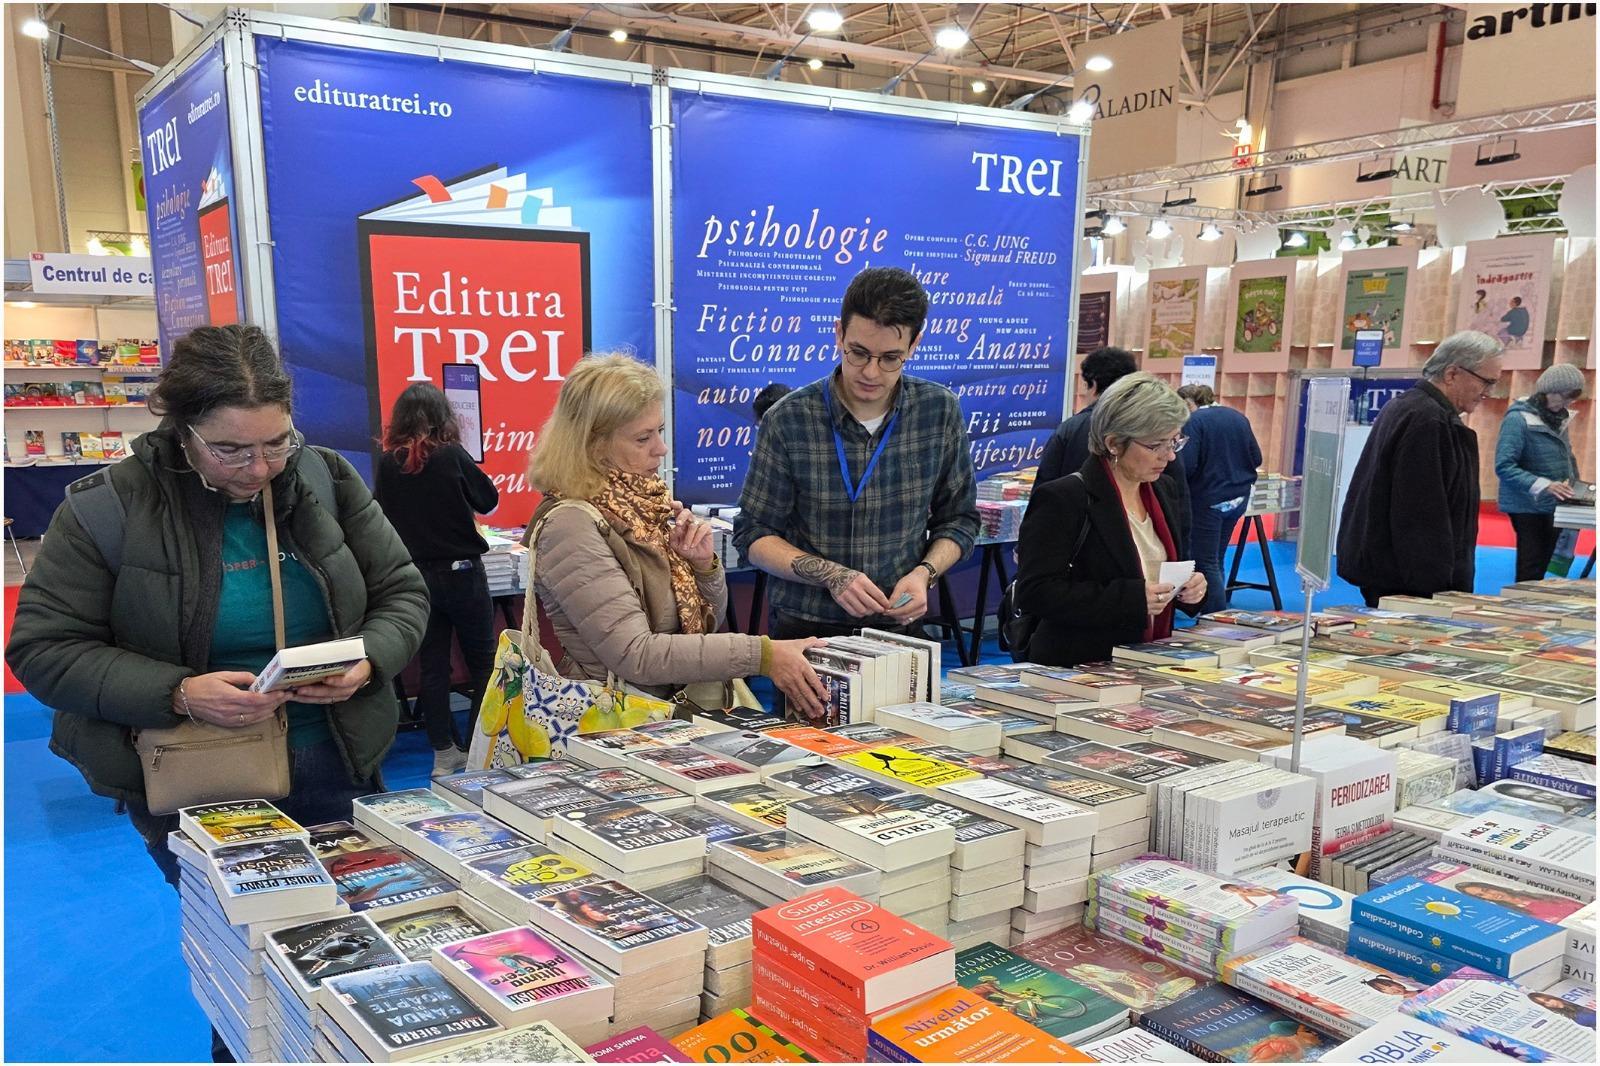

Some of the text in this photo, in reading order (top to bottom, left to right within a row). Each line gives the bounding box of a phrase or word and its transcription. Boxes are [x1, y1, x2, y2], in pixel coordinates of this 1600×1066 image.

[293, 79, 453, 118] edituratrei.ro
[147, 117, 181, 176] TREI
[972, 152, 1063, 196] TREI
[1396, 155, 1447, 184] ART
[204, 232, 230, 259] Editura
[696, 205, 888, 264] psihologie
[964, 234, 990, 248] C.G.
[993, 235, 1030, 250] JUNG
[964, 250, 1012, 266] Sigmund
[1015, 251, 1057, 265] FREUD
[43, 265, 132, 283] Centrul de
[207, 259, 233, 296] TREI
[393, 271, 565, 319] Editura
[696, 304, 801, 333] Fiction
[393, 326, 566, 382] TREI
[967, 333, 1052, 360] Anansi
[958, 384, 1006, 398] pentru
[1012, 380, 1048, 400] copii
[966, 411, 1001, 434] Fii
[696, 425, 751, 449] non
[970, 438, 1043, 470] lifestyle
[1331, 773, 1391, 808] PERIODIZAREA
[1513, 771, 1549, 786] LIMITE
[617, 828, 691, 849] ANA REYES
[877, 822, 935, 841] CHILD
[1228, 810, 1305, 840] Masajul terapeutic
[1311, 826, 1321, 880] PERIODIZAREA
[236, 875, 325, 892] LOUISE PENNY
[1526, 879, 1556, 892] KILLAM
[1539, 865, 1569, 879] KILLAM
[363, 887, 440, 908] MINIER
[789, 897, 832, 917] Super
[1360, 909, 1424, 939] Codul circadian
[757, 929, 789, 957] intestinul
[863, 942, 934, 971] Dr. William Davis
[1035, 937, 1114, 967] YOGA
[1358, 935, 1423, 965] Codul circadian
[488, 955, 568, 986] petrecere
[790, 952, 816, 971] Super
[955, 950, 1006, 971] TOMIA
[957, 955, 1013, 978] LISMULUI
[506, 978, 588, 1005] MACKINTOSH
[511, 970, 566, 989] Ultima
[757, 965, 792, 994] intestinul
[369, 991, 453, 1014] NOAPTE
[793, 986, 820, 1007] Super
[903, 1000, 973, 1035] Nivelul
[1172, 996, 1251, 1029] ANATOMIA
[1187, 1005, 1264, 1037] ÎNOTULUI
[389, 1017, 488, 1044] TRACY SIERRA
[792, 1019, 818, 1040] Super
[914, 1005, 994, 1048] următor
[590, 1034, 647, 1059] ROMI SHINYA
[1086, 1034, 1158, 1062] ATOMIA
[1359, 1030, 1434, 1063] BIBLIA
